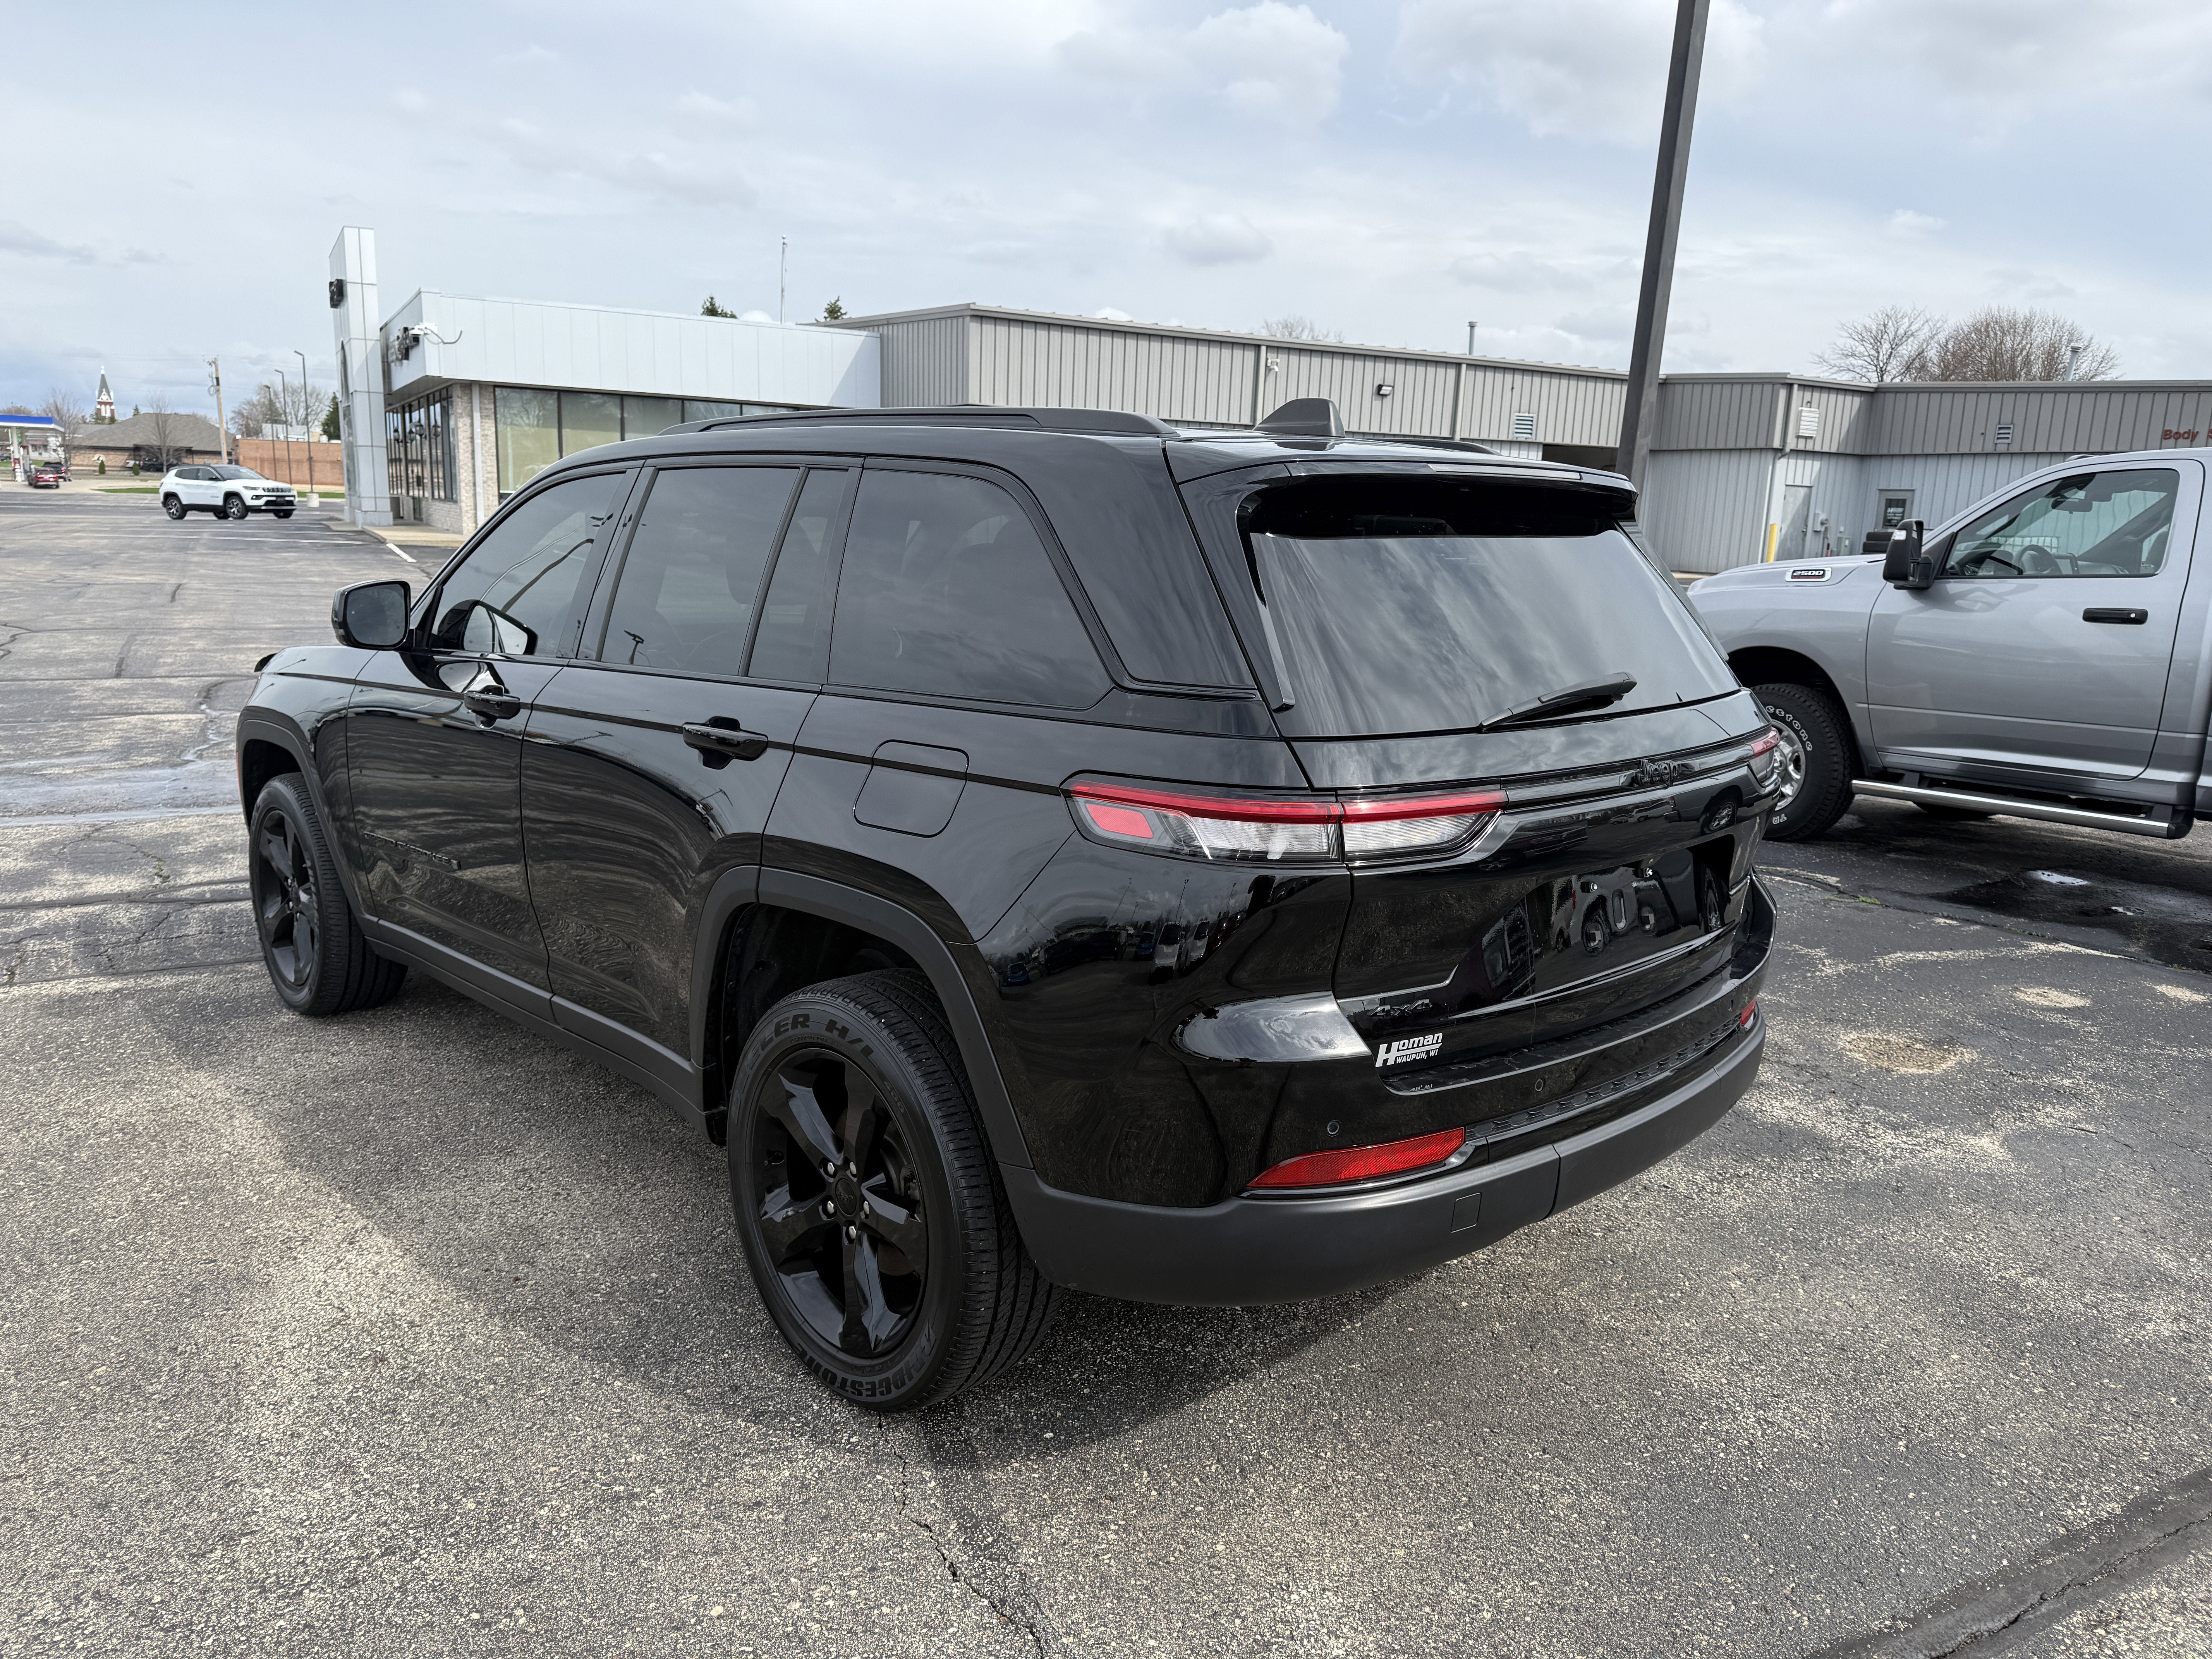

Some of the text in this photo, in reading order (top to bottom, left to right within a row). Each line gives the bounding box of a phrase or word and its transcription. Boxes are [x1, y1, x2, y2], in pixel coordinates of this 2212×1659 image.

[2163, 429, 2199, 443] Body
[1766, 705, 1813, 751] estone
[1634, 759, 1681, 788] Jeep
[1772, 814, 1787, 824] TR
[1375, 1033, 1443, 1067] Homan
[1396, 1049, 1439, 1064] WAUPUN, WI
